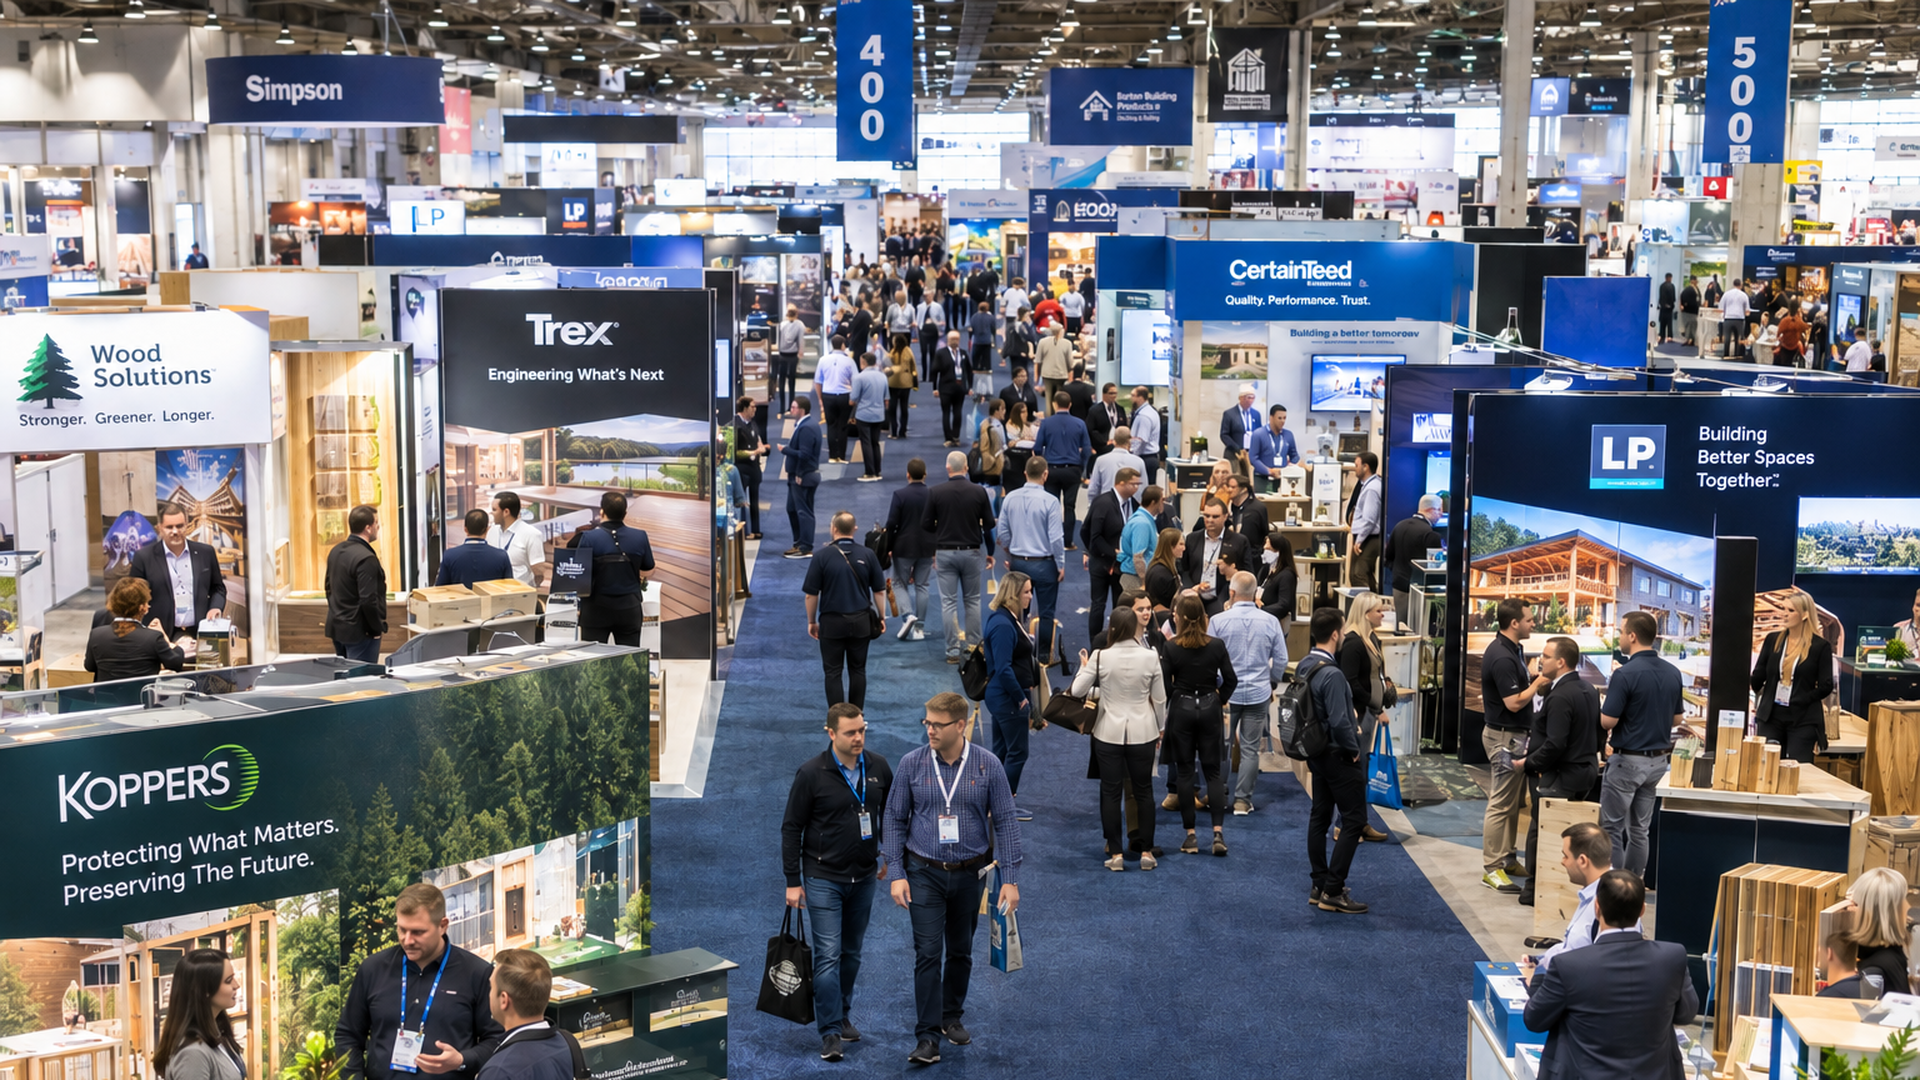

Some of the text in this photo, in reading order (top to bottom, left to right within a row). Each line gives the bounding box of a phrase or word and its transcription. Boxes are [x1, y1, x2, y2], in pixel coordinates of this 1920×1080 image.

[245, 74, 343, 106] Simpson
[860, 34, 885, 142] 400
[1728, 36, 1757, 144] 500
[564, 202, 586, 222] LP
[1229, 259, 1352, 280] CertainTeed
[1225, 294, 1371, 307] Quality. Performance. Trust.
[90, 343, 163, 364] Wood
[488, 367, 665, 384] Engineering What's Next
[19, 410, 215, 429] Stronger. Greener. Longer.
[1699, 425, 1768, 446] Building
[1697, 449, 1815, 468] Better Spaces
[58, 761, 231, 823] KOPPERS
[62, 818, 340, 875] Protecting What Matters.
[64, 852, 314, 906] Preserving The Future.
